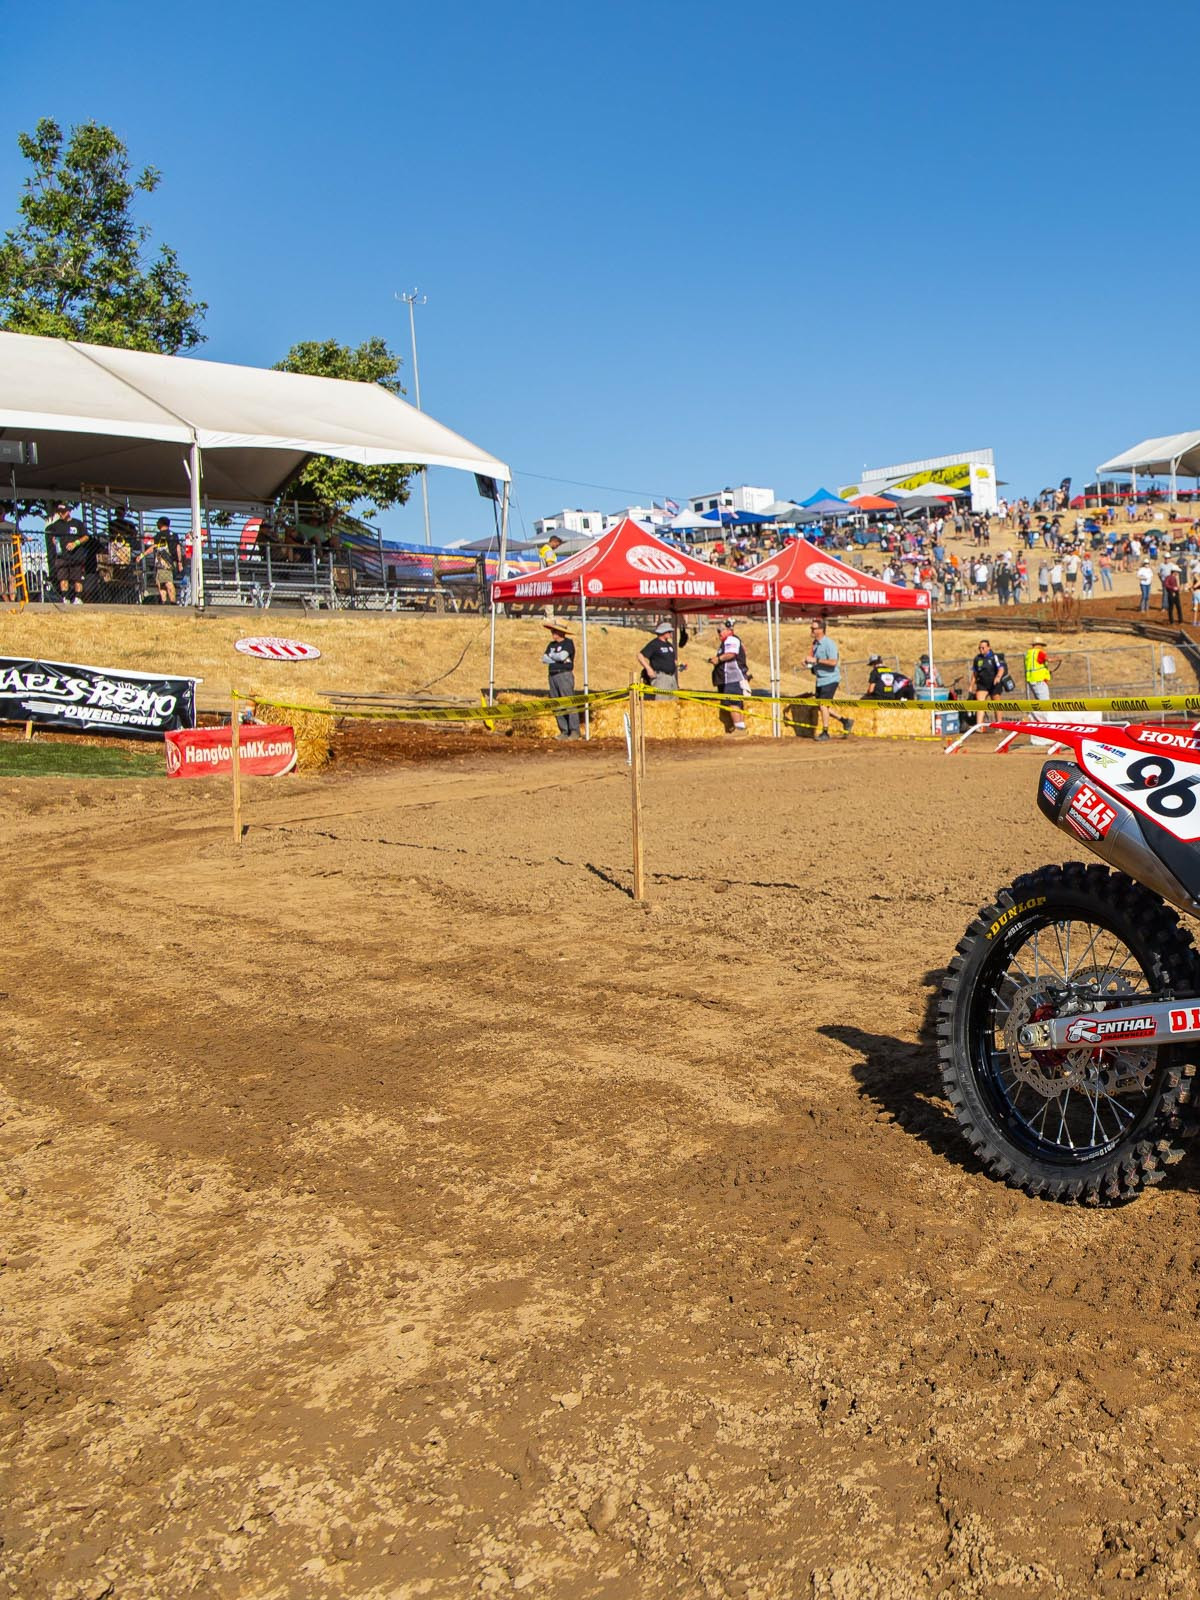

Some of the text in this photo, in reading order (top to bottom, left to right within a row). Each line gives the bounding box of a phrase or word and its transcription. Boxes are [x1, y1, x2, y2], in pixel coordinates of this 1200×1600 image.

[640, 580, 716, 595] HANGTOWN
[823, 587, 887, 604] HANGTOWN
[87, 676, 177, 716] RENO
[934, 703, 967, 711] CAUTION
[987, 702, 1021, 711] CUIDADO
[1052, 701, 1086, 711] CAUTION
[1111, 700, 1149, 711] CUIDADO
[991, 896, 1046, 935] DUNLOP
[1067, 1017, 1155, 1042] RENTHAL
